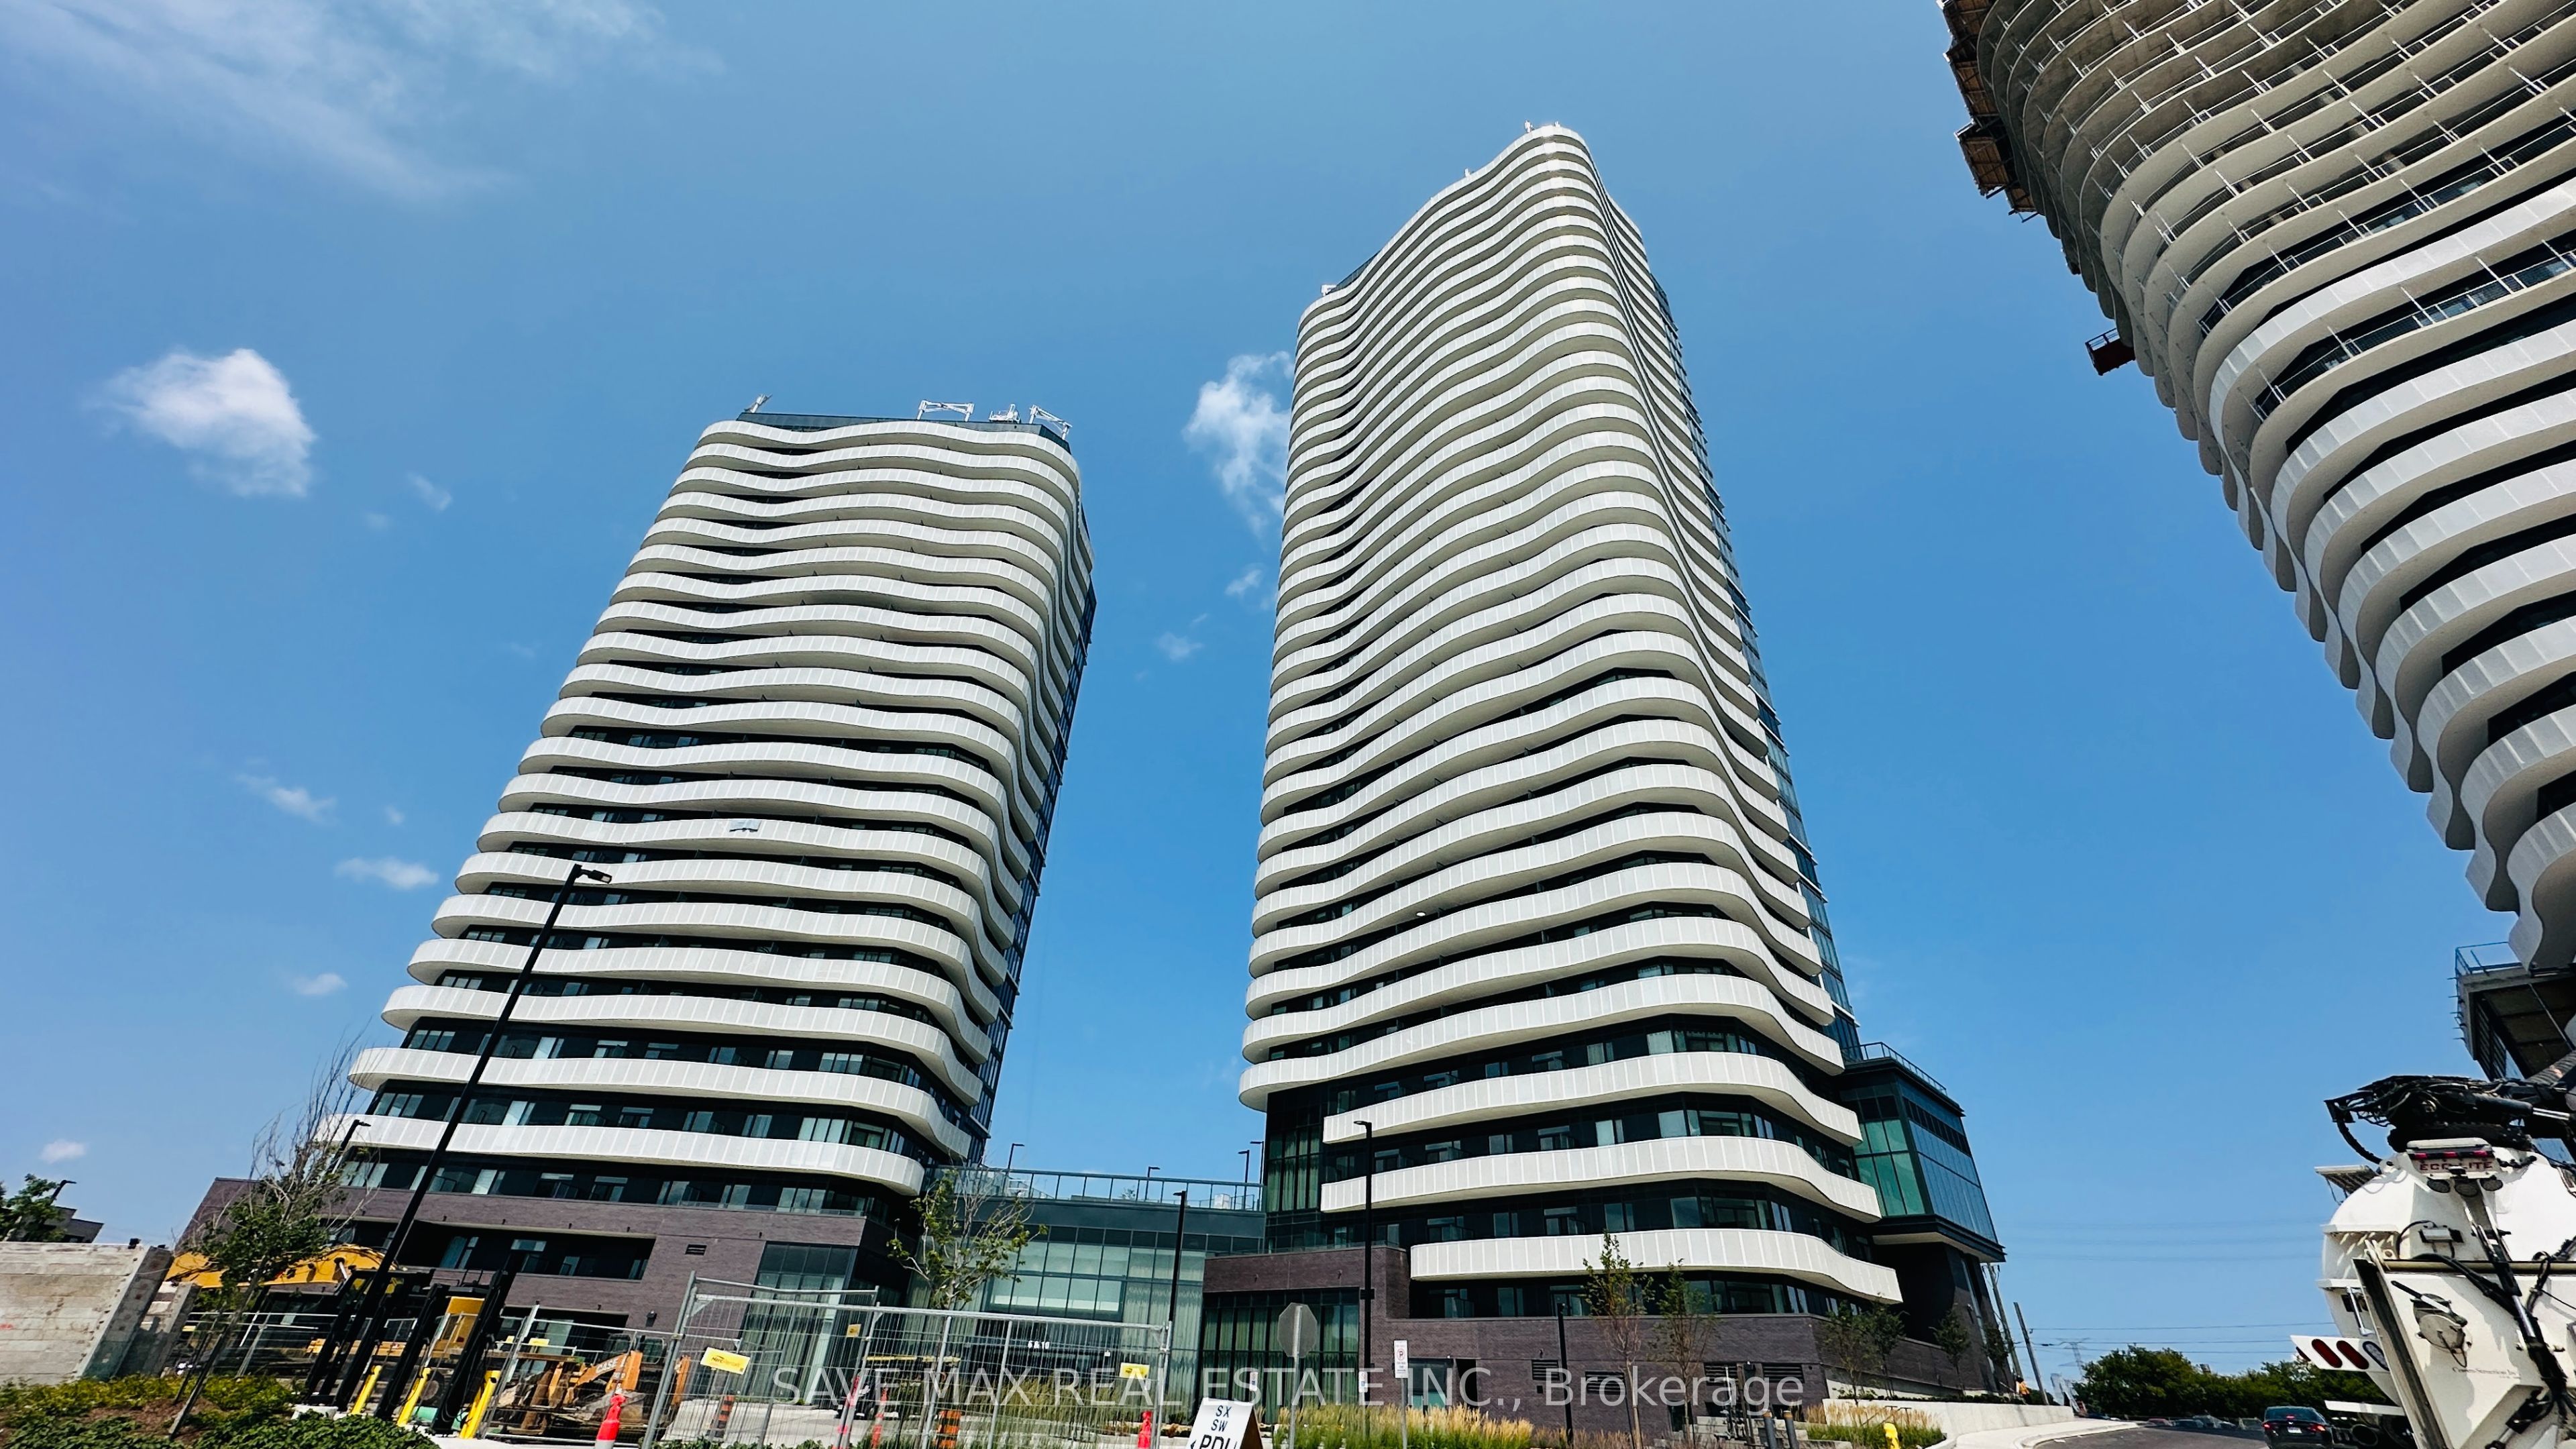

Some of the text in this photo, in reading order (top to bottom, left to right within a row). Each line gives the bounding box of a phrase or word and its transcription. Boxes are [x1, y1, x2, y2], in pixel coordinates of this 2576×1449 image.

[596, 1356, 619, 1373] CASE
[1216, 1405, 1232, 1417] SX
[1211, 1419, 1228, 1432] SW
